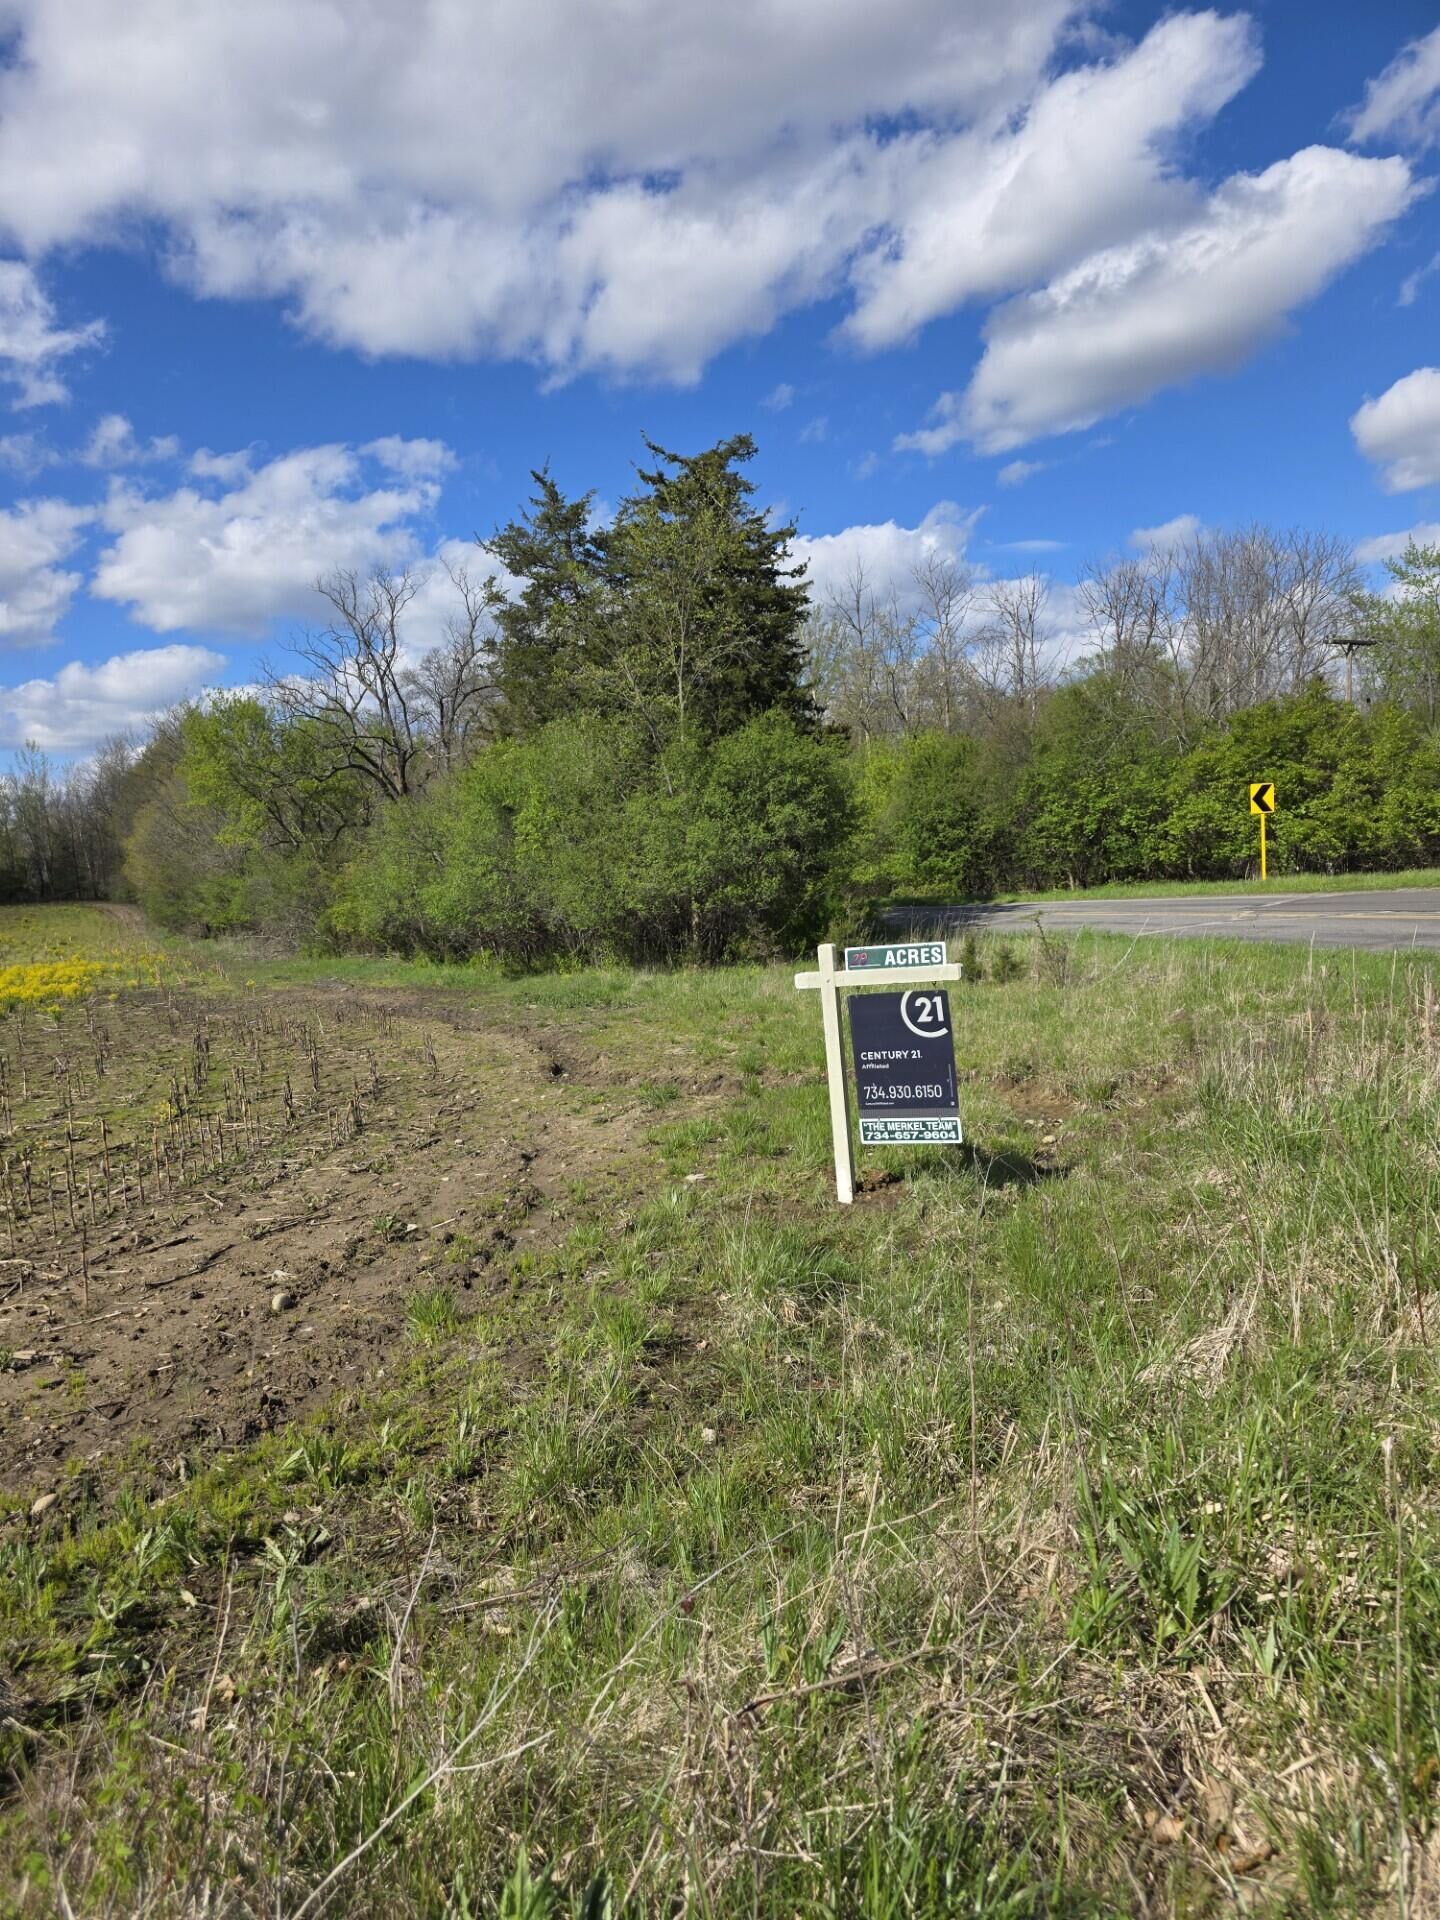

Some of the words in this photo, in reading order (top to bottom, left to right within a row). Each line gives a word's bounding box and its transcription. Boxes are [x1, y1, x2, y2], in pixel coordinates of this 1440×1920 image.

[884, 946, 942, 966] ACRES
[860, 1050, 909, 1060] CENTURY
[863, 1084, 942, 1099] 734.930.6150
[887, 1121, 925, 1131] MERKEL
[865, 1131, 956, 1140] 734-657-9604
